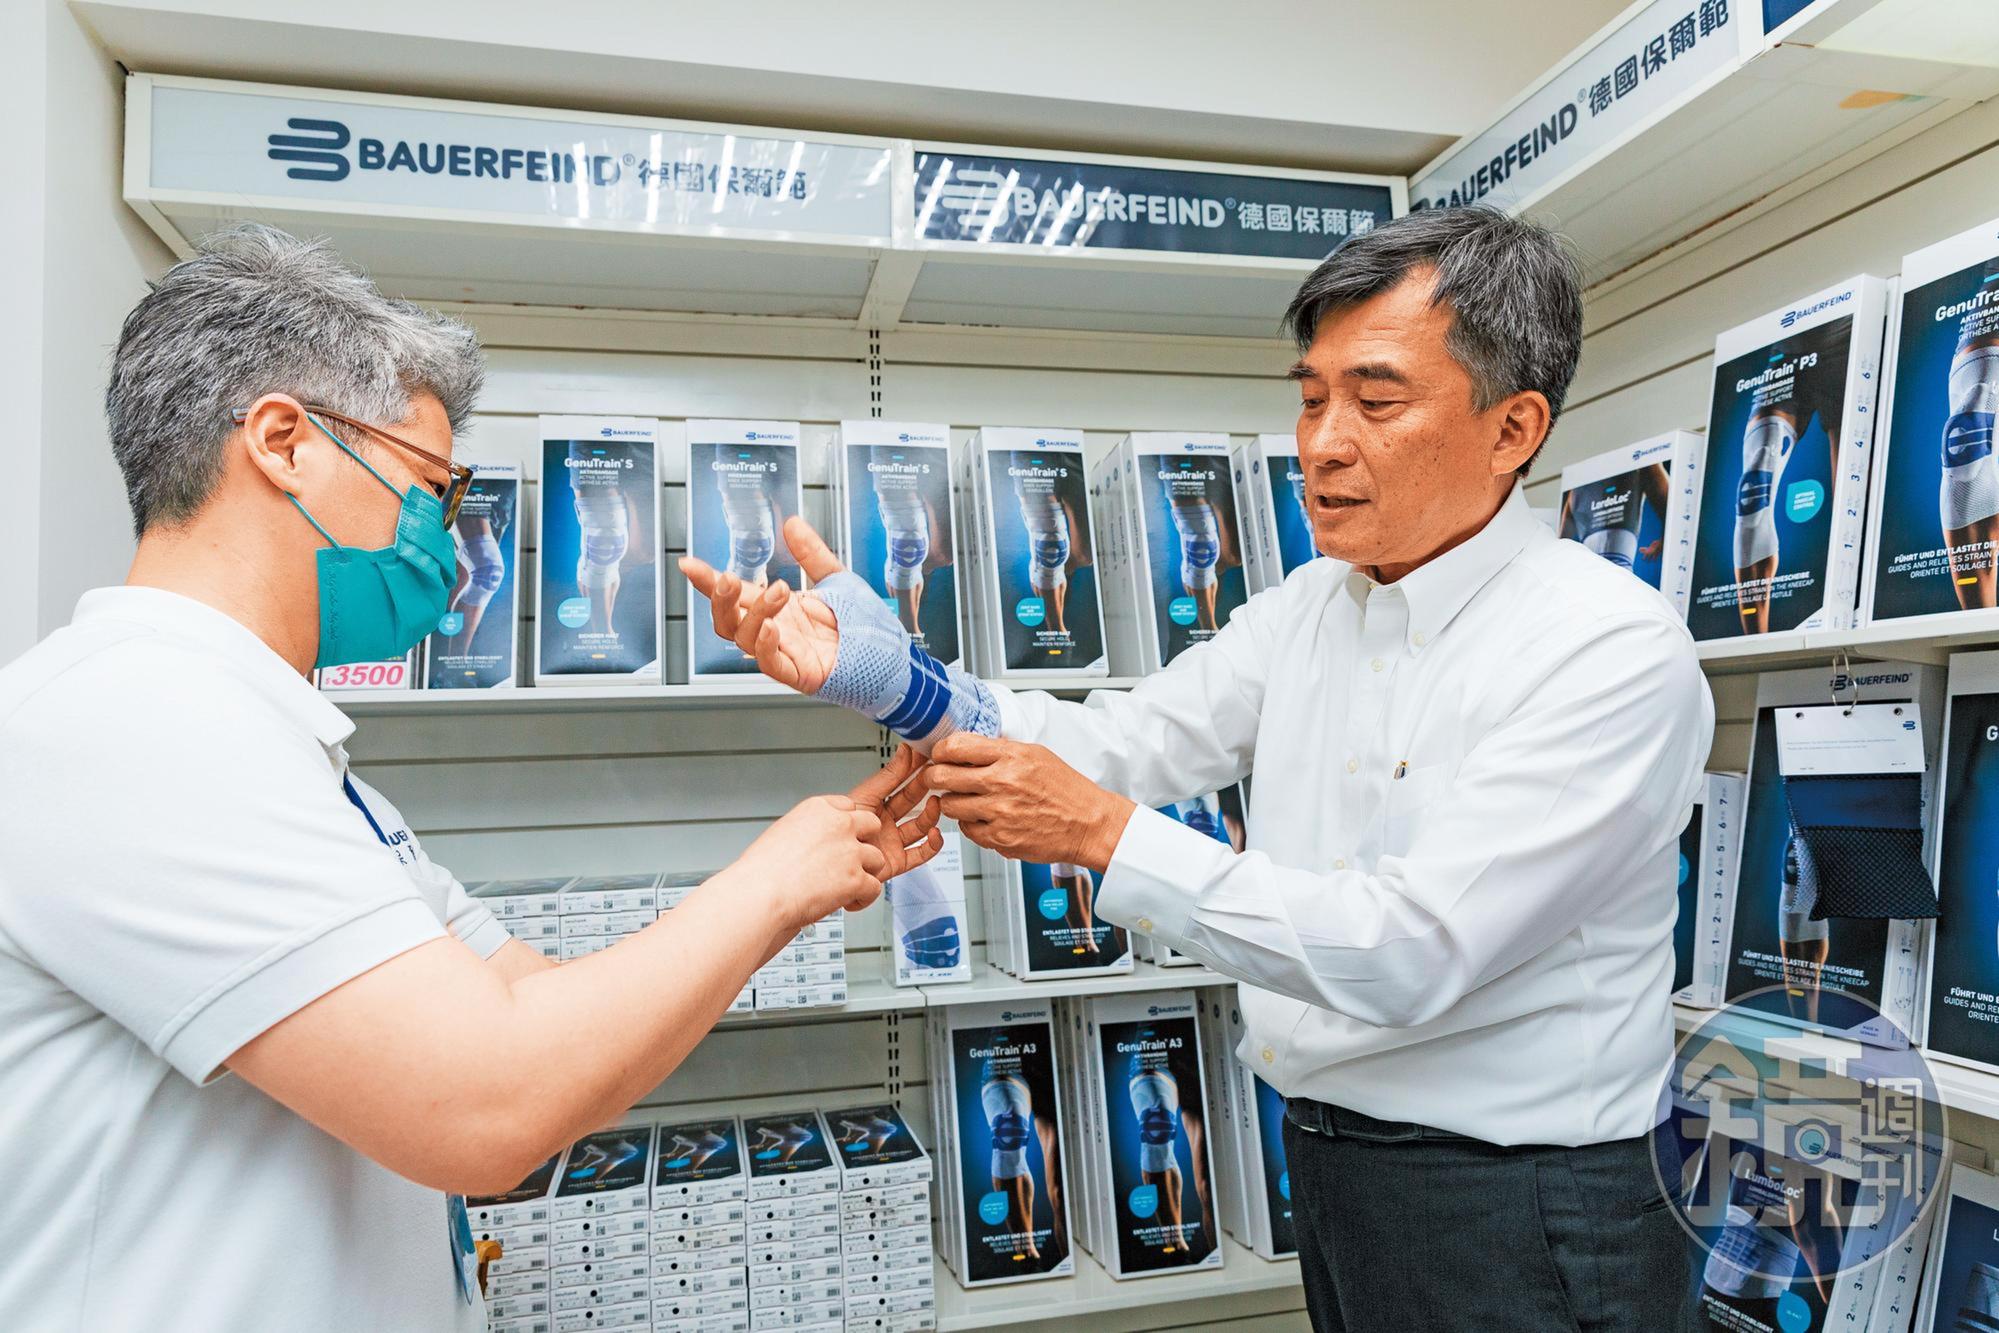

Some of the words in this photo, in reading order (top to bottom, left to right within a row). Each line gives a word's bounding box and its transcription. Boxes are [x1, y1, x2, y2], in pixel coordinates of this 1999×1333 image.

[1800, 352, 1818, 370] P3
[1862, 371, 1871, 380] 6
[1858, 404, 1868, 413] 5
[1854, 440, 1864, 448] 4
[625, 459, 634, 469] S
[769, 462, 778, 472] S
[922, 464, 930, 474] S
[1060, 467, 1068, 477] S
[1208, 471, 1216, 480] S
[1850, 473, 1861, 482] 3
[1847, 508, 1857, 517] 2
[1920, 550, 1936, 560] UND
[1888, 563, 1912, 574] GUIDES
[1913, 560, 1928, 569] AND
[1964, 550, 1992, 561] STRAIN
[1678, 564, 1687, 572] 2
[1910, 566, 1939, 579] ORIENTE
[1941, 566, 1950, 574] ET
[1720, 798, 1729, 806] 7
[1718, 821, 1727, 829] 6
[1716, 869, 1725, 877] 4
[1714, 892, 1723, 900] 3
[1713, 916, 1722, 924] 2
[1950, 986, 1976, 999] FÜHRT
[1977, 993, 1994, 1003] UND
[1944, 996, 1969, 1008] GUIDES
[1970, 1002, 1986, 1011] AND
[1169, 1037, 1183, 1049] A3
[1023, 1043, 1037, 1054] A3
[1846, 1312, 1856, 1322] 2
[1854, 1282, 1863, 1291] 3
[1862, 1253, 1871, 1262] 4
[1869, 1222, 1879, 1231] 5
[1890, 1304, 1900, 1314] 2
[1897, 1275, 1907, 1283] 3
[1904, 1246, 1913, 1254] 4
